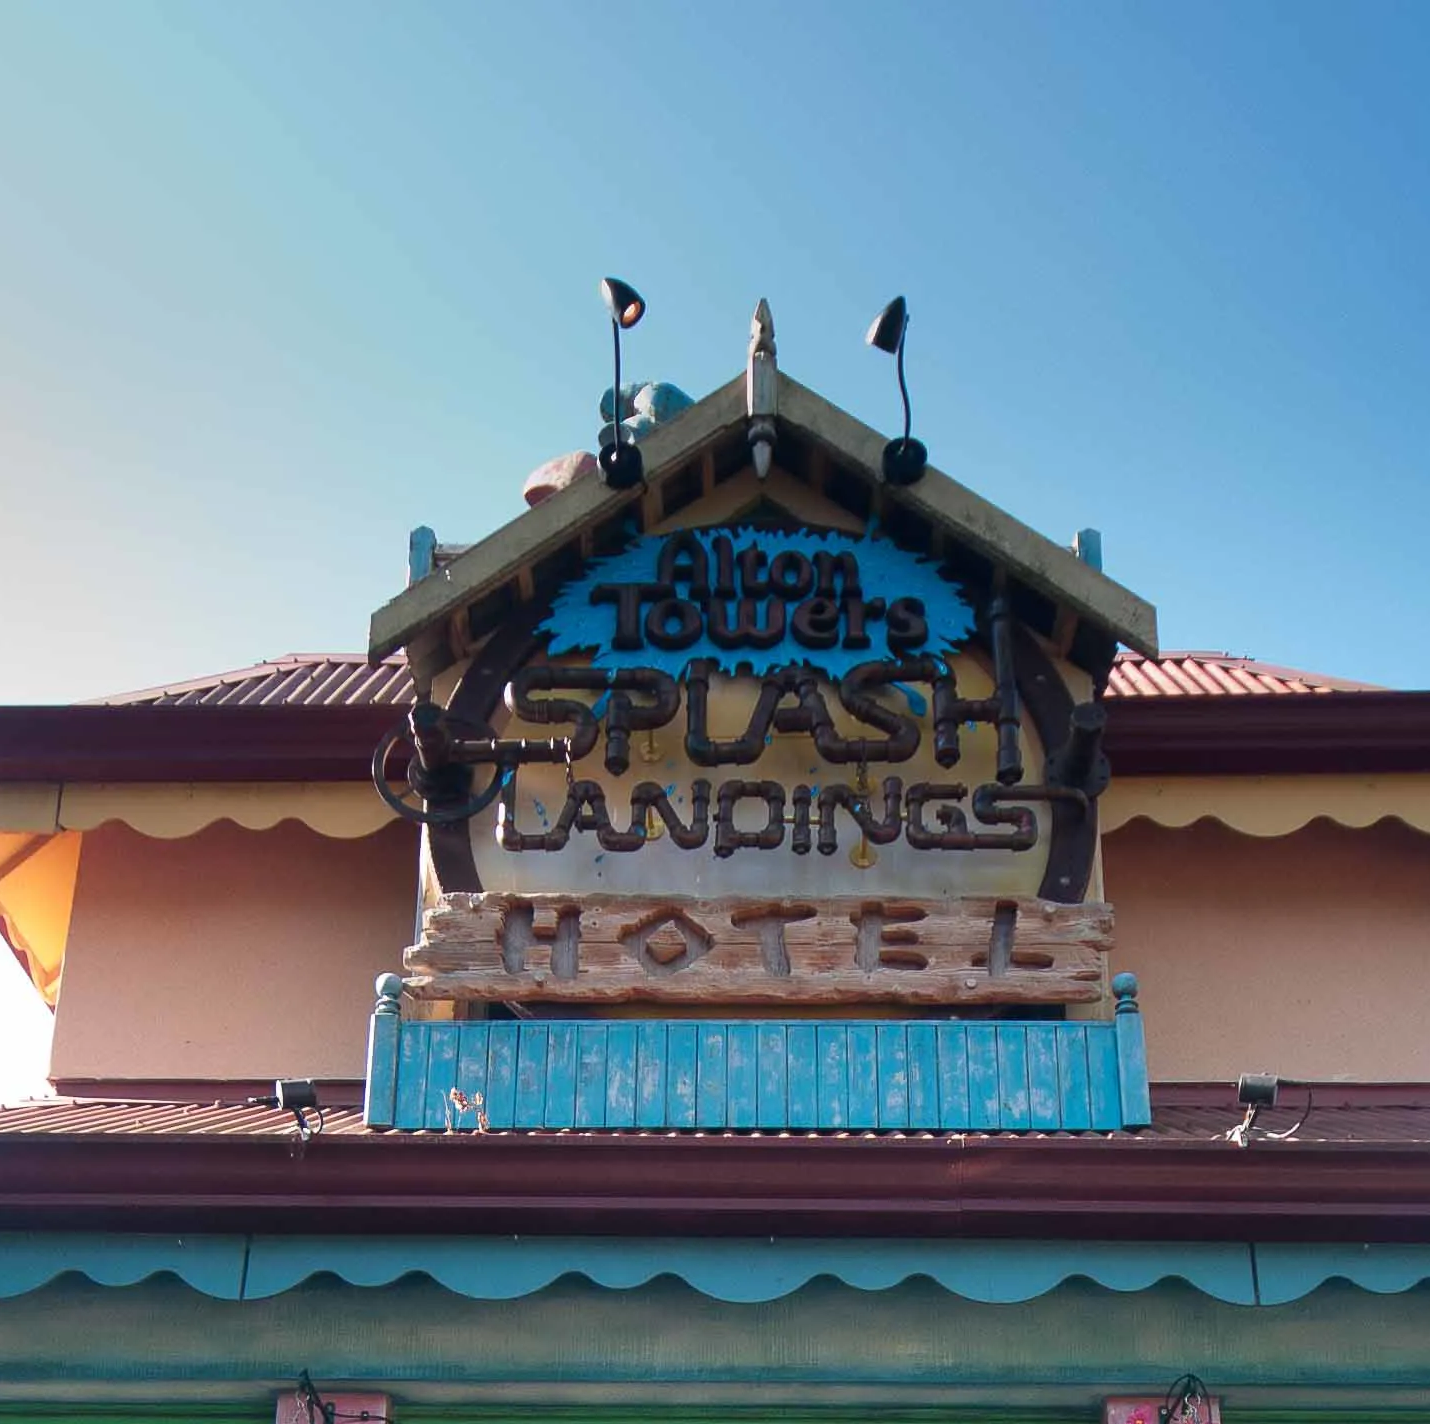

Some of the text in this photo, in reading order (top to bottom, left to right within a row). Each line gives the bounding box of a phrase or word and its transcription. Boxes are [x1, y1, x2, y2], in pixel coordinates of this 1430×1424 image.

[657, 530, 863, 600] Alton
[589, 583, 929, 651] Towers
[505, 656, 1023, 785] SPLASH
[496, 768, 1041, 859] LANDINGS
[495, 900, 1054, 980] HOTEL
